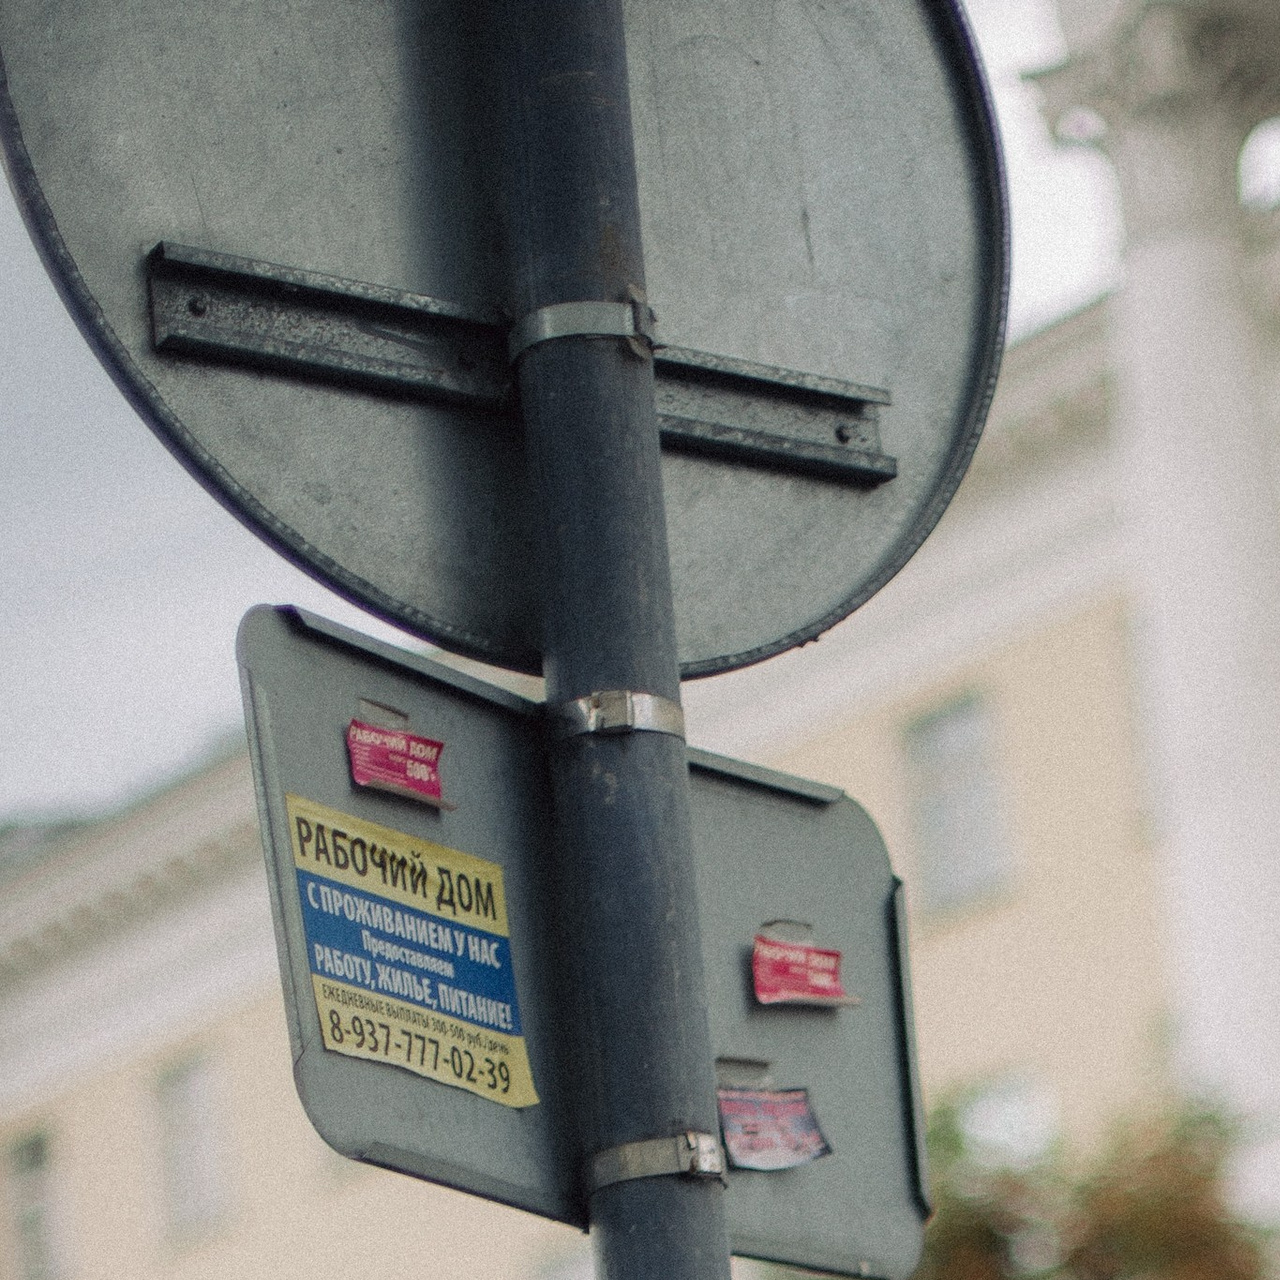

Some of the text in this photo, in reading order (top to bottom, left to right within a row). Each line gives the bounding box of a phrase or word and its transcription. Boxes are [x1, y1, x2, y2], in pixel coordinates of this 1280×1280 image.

[295, 815, 498, 921] РАБОЧИЙ ДОМ
[306, 881, 500, 970] С ПРОЖИВАНИЕМ У НАС
[360, 929, 455, 979] Предоставляем
[313, 943, 514, 1030] РАБОТУ, ЖИЛЬЕ, ПИТАНИЕ!
[321, 983, 386, 1015] ЕЖЕДНЕВНЫЕ
[386, 1002, 430, 1029] ВЫПЛАТЫ
[328, 1008, 511, 1094] 8-937-777-02-39
